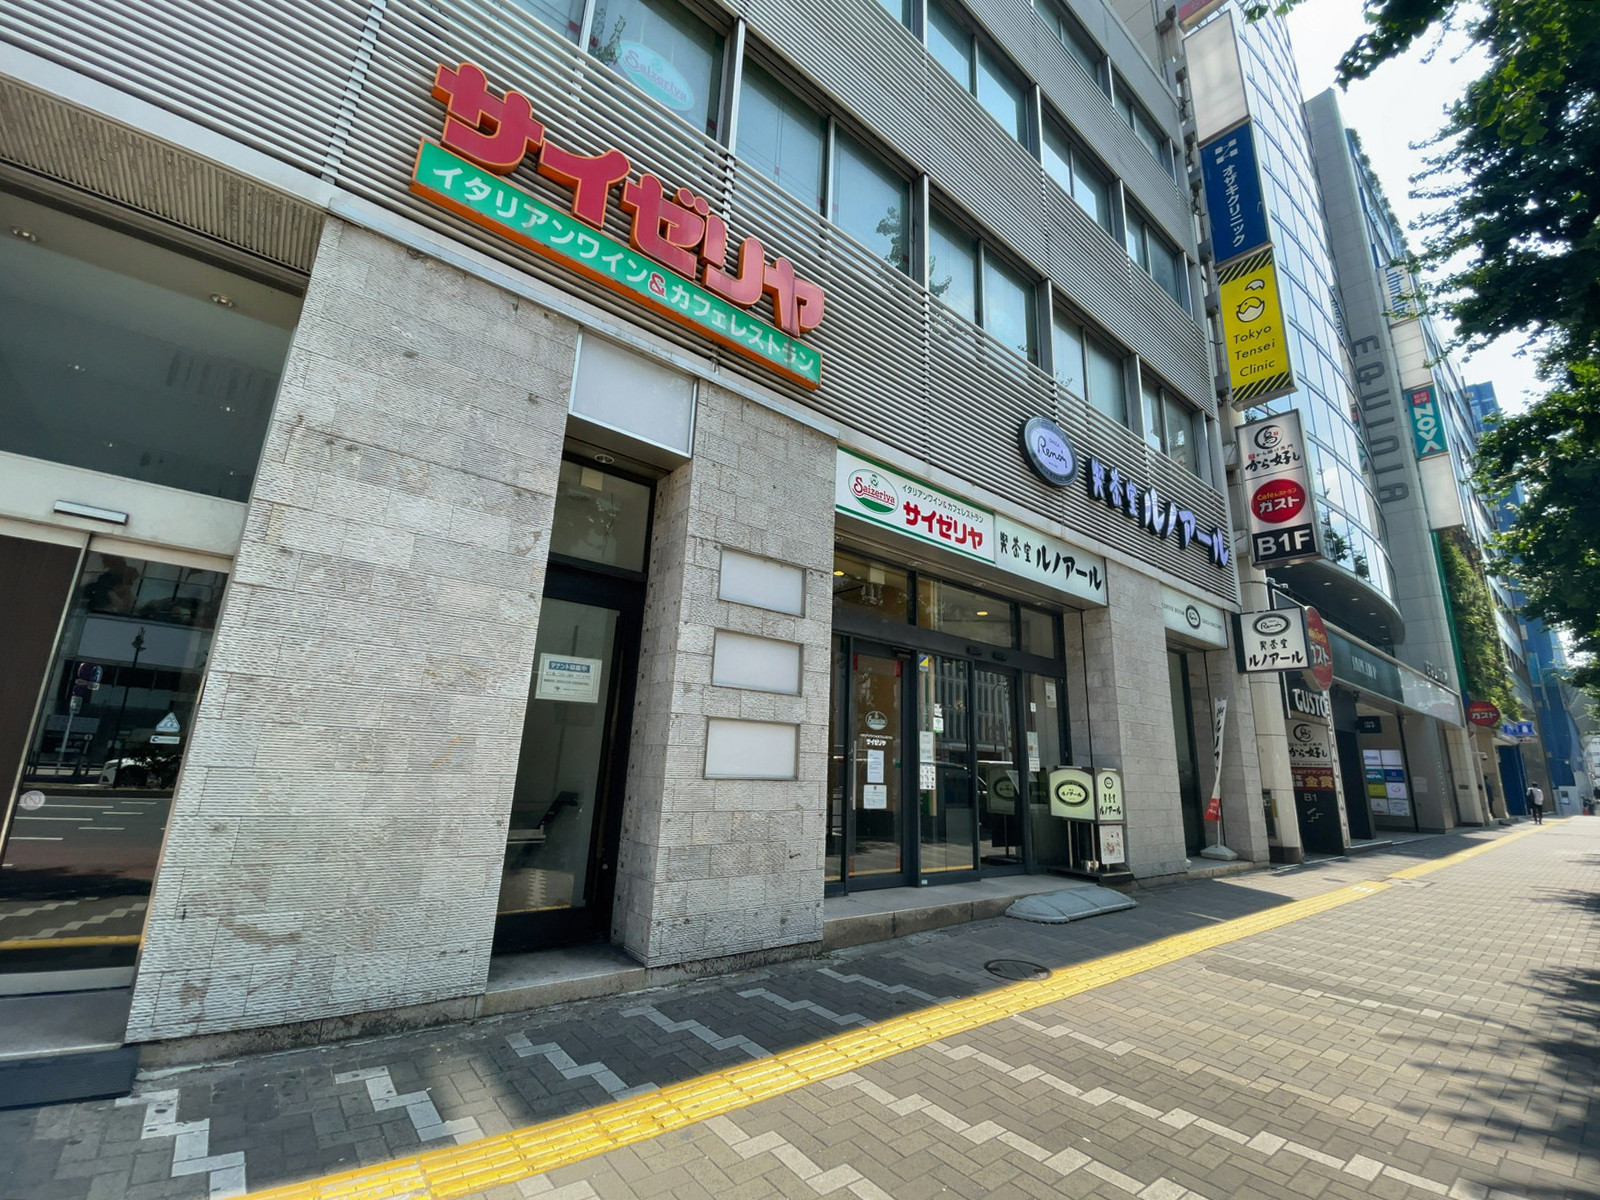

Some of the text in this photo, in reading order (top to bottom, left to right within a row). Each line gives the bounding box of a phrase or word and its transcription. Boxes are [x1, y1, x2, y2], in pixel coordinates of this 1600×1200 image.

[624, 49, 687, 101] Saizeriya
[434, 62, 824, 338] サイゼリヤ
[1222, 164, 1245, 247] オザキクリニック
[433, 167, 815, 372] イタリアンワイン&カフェレストラン
[1233, 326, 1272, 344] Tokyo
[1235, 338, 1275, 360] Tensei
[1240, 360, 1275, 377] Clinic
[1413, 402, 1443, 454] NOVA
[1245, 450, 1300, 472] から好し
[853, 476, 896, 506] Saizeriya
[902, 484, 984, 524] イタリアンワイン&カフェレストラン
[1259, 496, 1300, 514] ガスト
[903, 501, 983, 550] サイゼリヤ
[1257, 529, 1310, 556] B1F
[1249, 650, 1304, 667] ルノアール
[1260, 638, 1288, 651] 喫茶室
[1292, 688, 1328, 718] GUSTO
